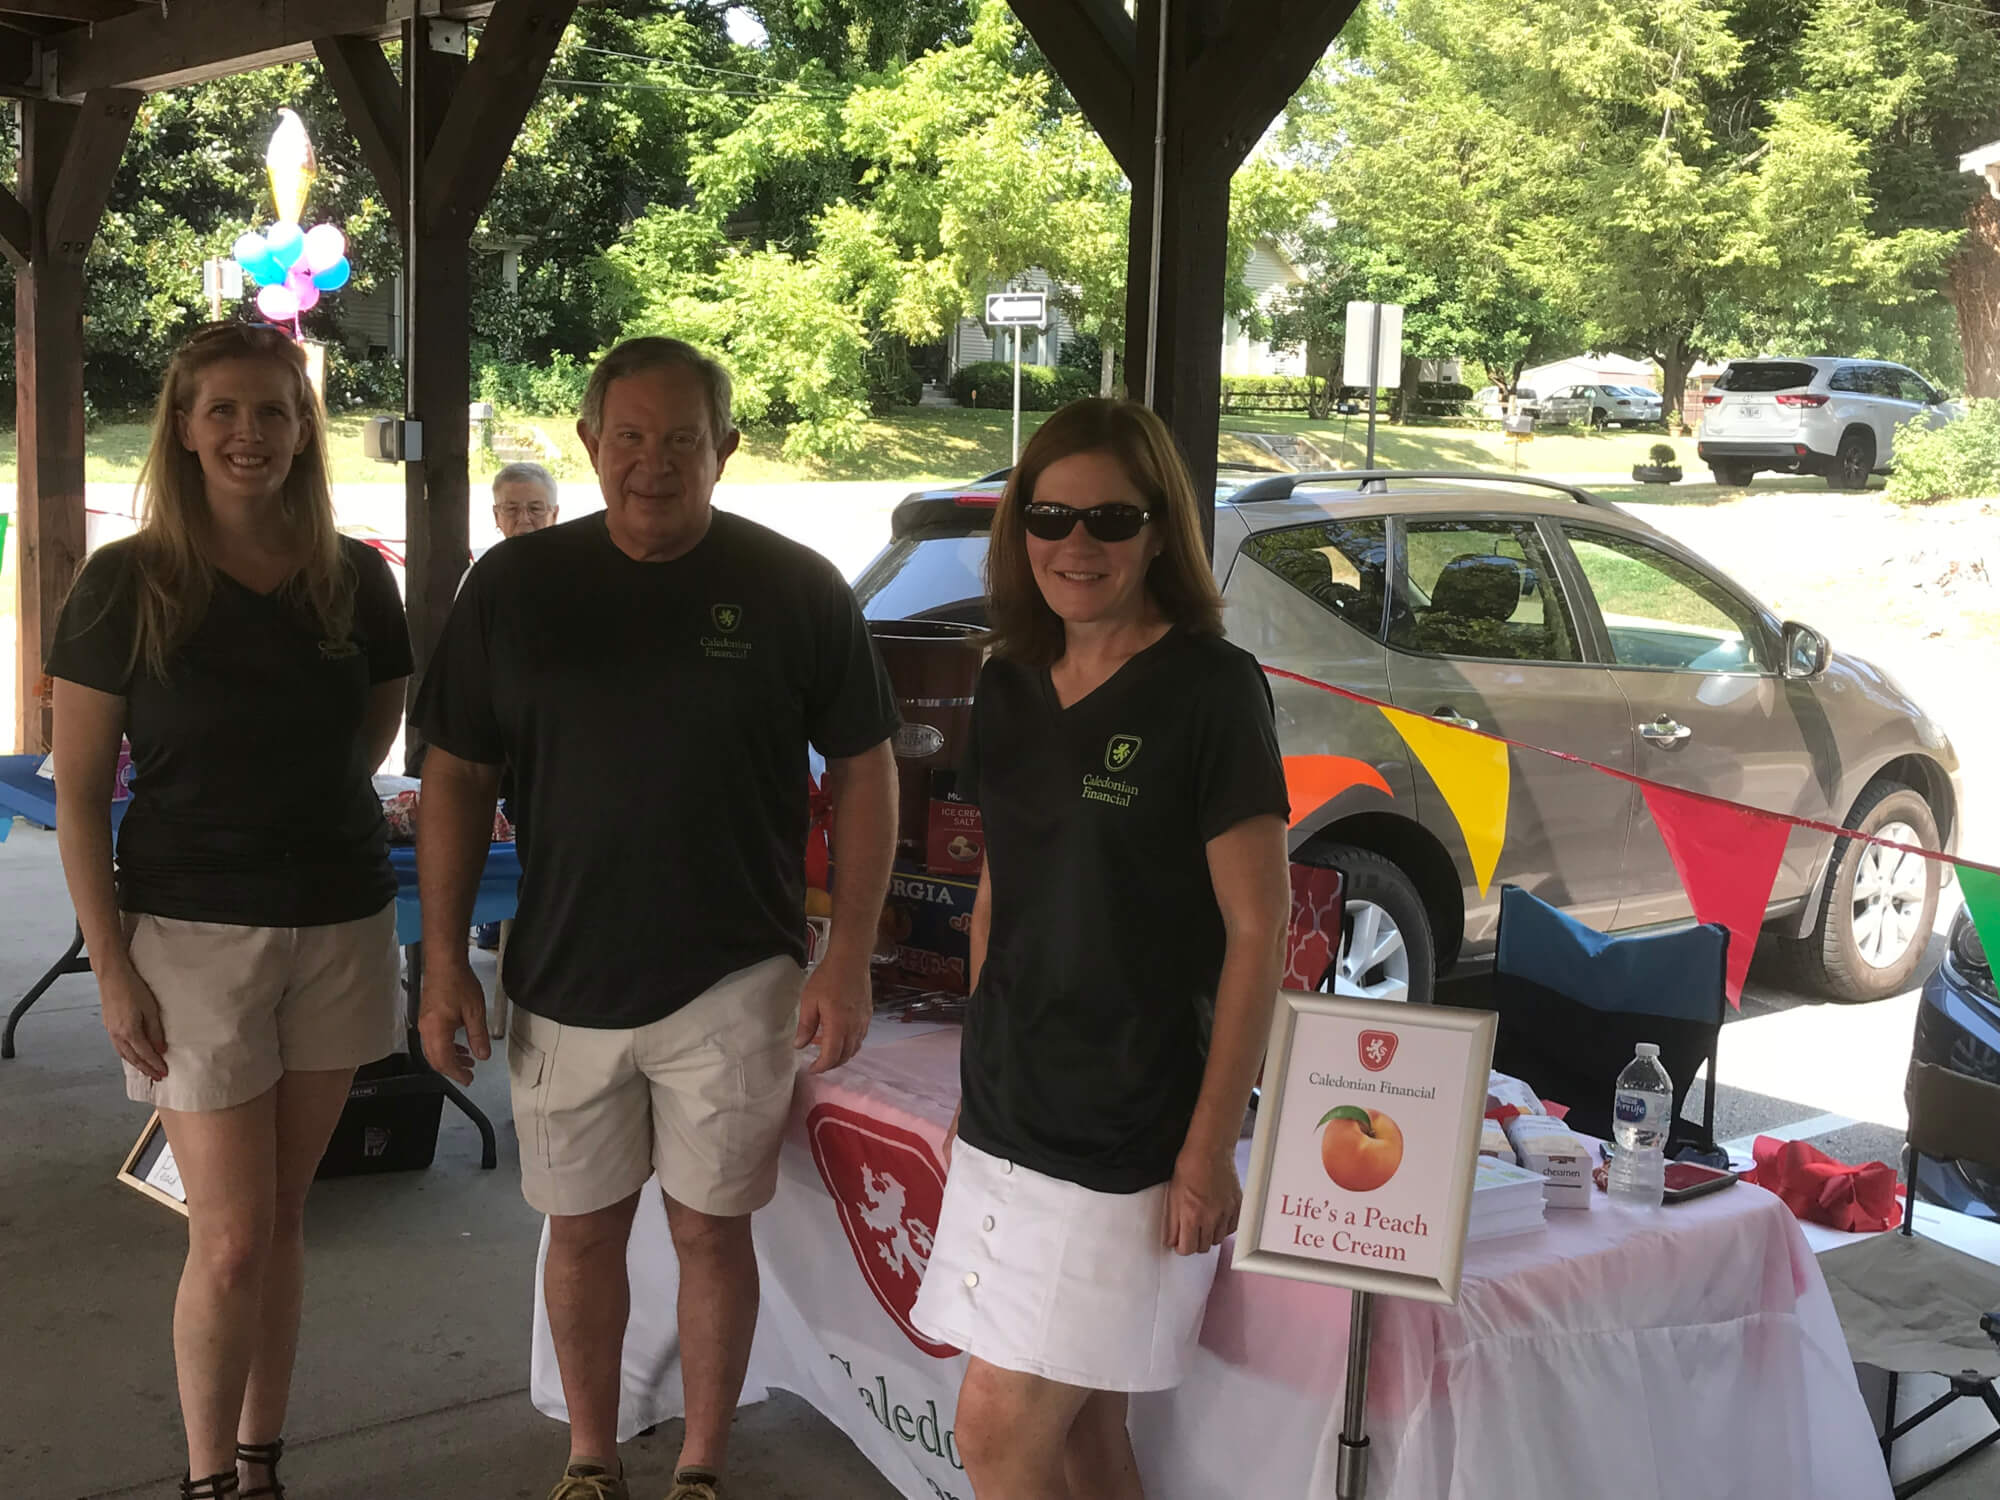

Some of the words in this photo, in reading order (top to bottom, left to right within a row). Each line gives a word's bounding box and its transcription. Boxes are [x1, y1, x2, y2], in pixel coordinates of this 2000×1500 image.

[1082, 773, 1139, 796] Caledonian
[1081, 785, 1132, 807] Financial
[941, 807, 956, 817] ICE
[953, 817, 976, 827] SALT
[1308, 1071, 1377, 1094] Caledonian
[1379, 1080, 1436, 1100] Financial
[1542, 1167, 1581, 1178] chessmen
[1280, 1194, 1338, 1223] Life's
[1344, 1208, 1356, 1225] a
[1363, 1206, 1428, 1237] Peach
[1292, 1224, 1325, 1248] Ice
[1332, 1231, 1407, 1262] Cream
